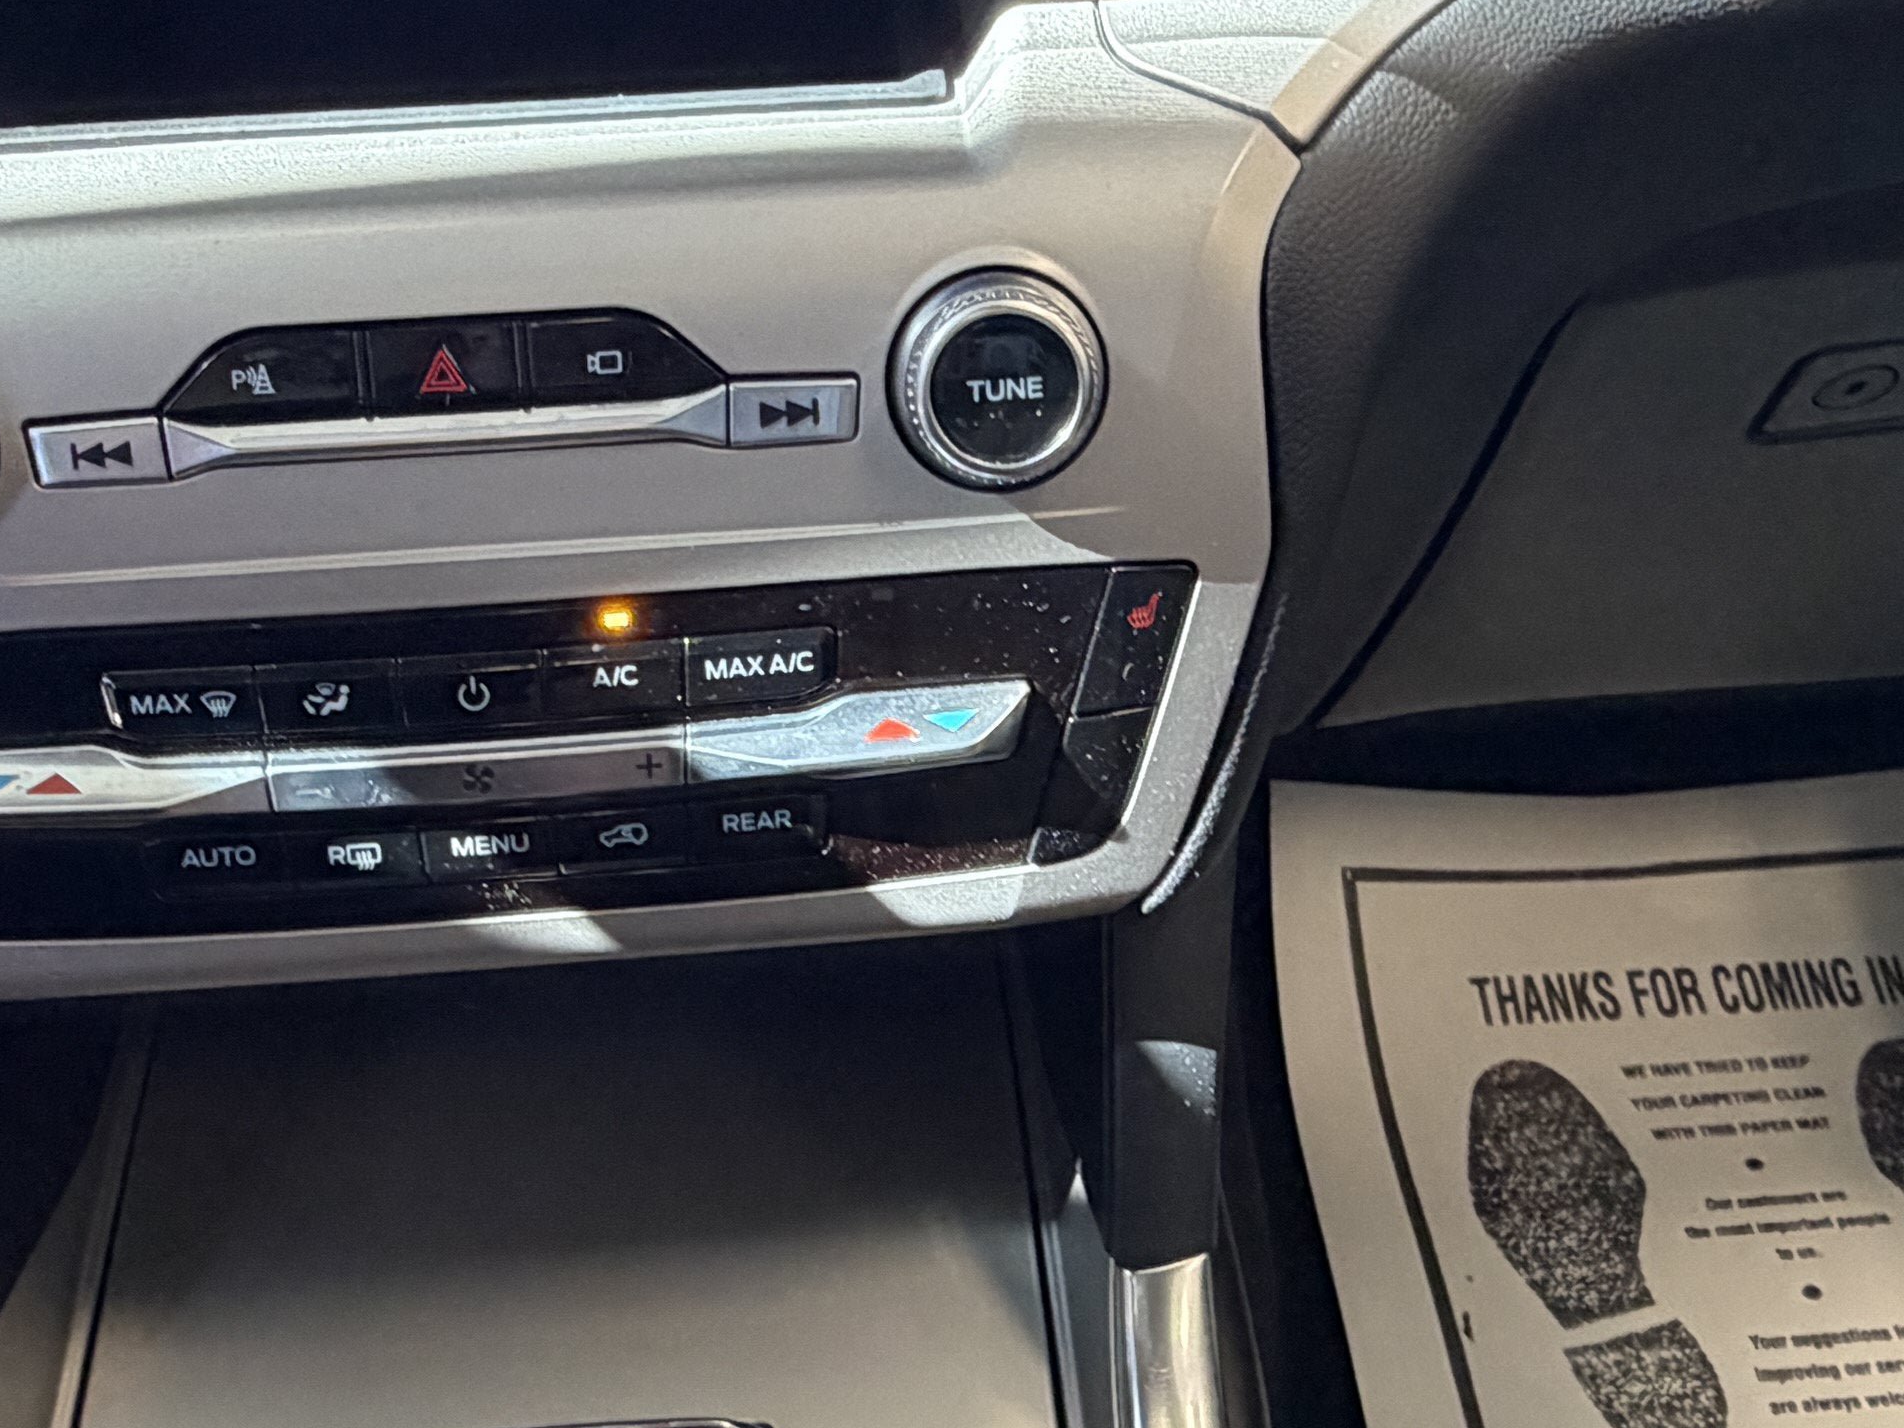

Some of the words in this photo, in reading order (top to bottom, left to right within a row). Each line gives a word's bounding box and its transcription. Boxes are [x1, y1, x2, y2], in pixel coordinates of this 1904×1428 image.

[965, 375, 1045, 403] TUNE
[590, 663, 639, 688] A/C
[703, 654, 766, 682] MAX
[767, 649, 815, 676] A/C
[129, 692, 193, 717] MAX
[722, 809, 792, 834] REAR
[181, 844, 257, 870] AUTO
[450, 832, 530, 858] MENU
[1468, 972, 1622, 1026] THANKS
[1626, 966, 1707, 1018] FOR
[1711, 956, 1862, 1015] COMING
[1620, 1063, 1647, 1079] WE
[1648, 1062, 1693, 1077] HAVE
[1694, 1058, 1743, 1074] TRIED
[1745, 1056, 1769, 1072] TO
[1630, 1095, 1677, 1111] YOUR
[1772, 1086, 1827, 1102] CLEAN
[1650, 1126, 1696, 1140] WITH
[1739, 1119, 1794, 1135] PAPER
[1795, 1116, 1830, 1131] MAT
[1748, 1334, 1787, 1350] Your
[1790, 1328, 1893, 1349] suggestions
[1844, 1361, 1871, 1376] our
[1769, 1400, 1798, 1416] are
[1802, 1396, 1862, 1413] always
